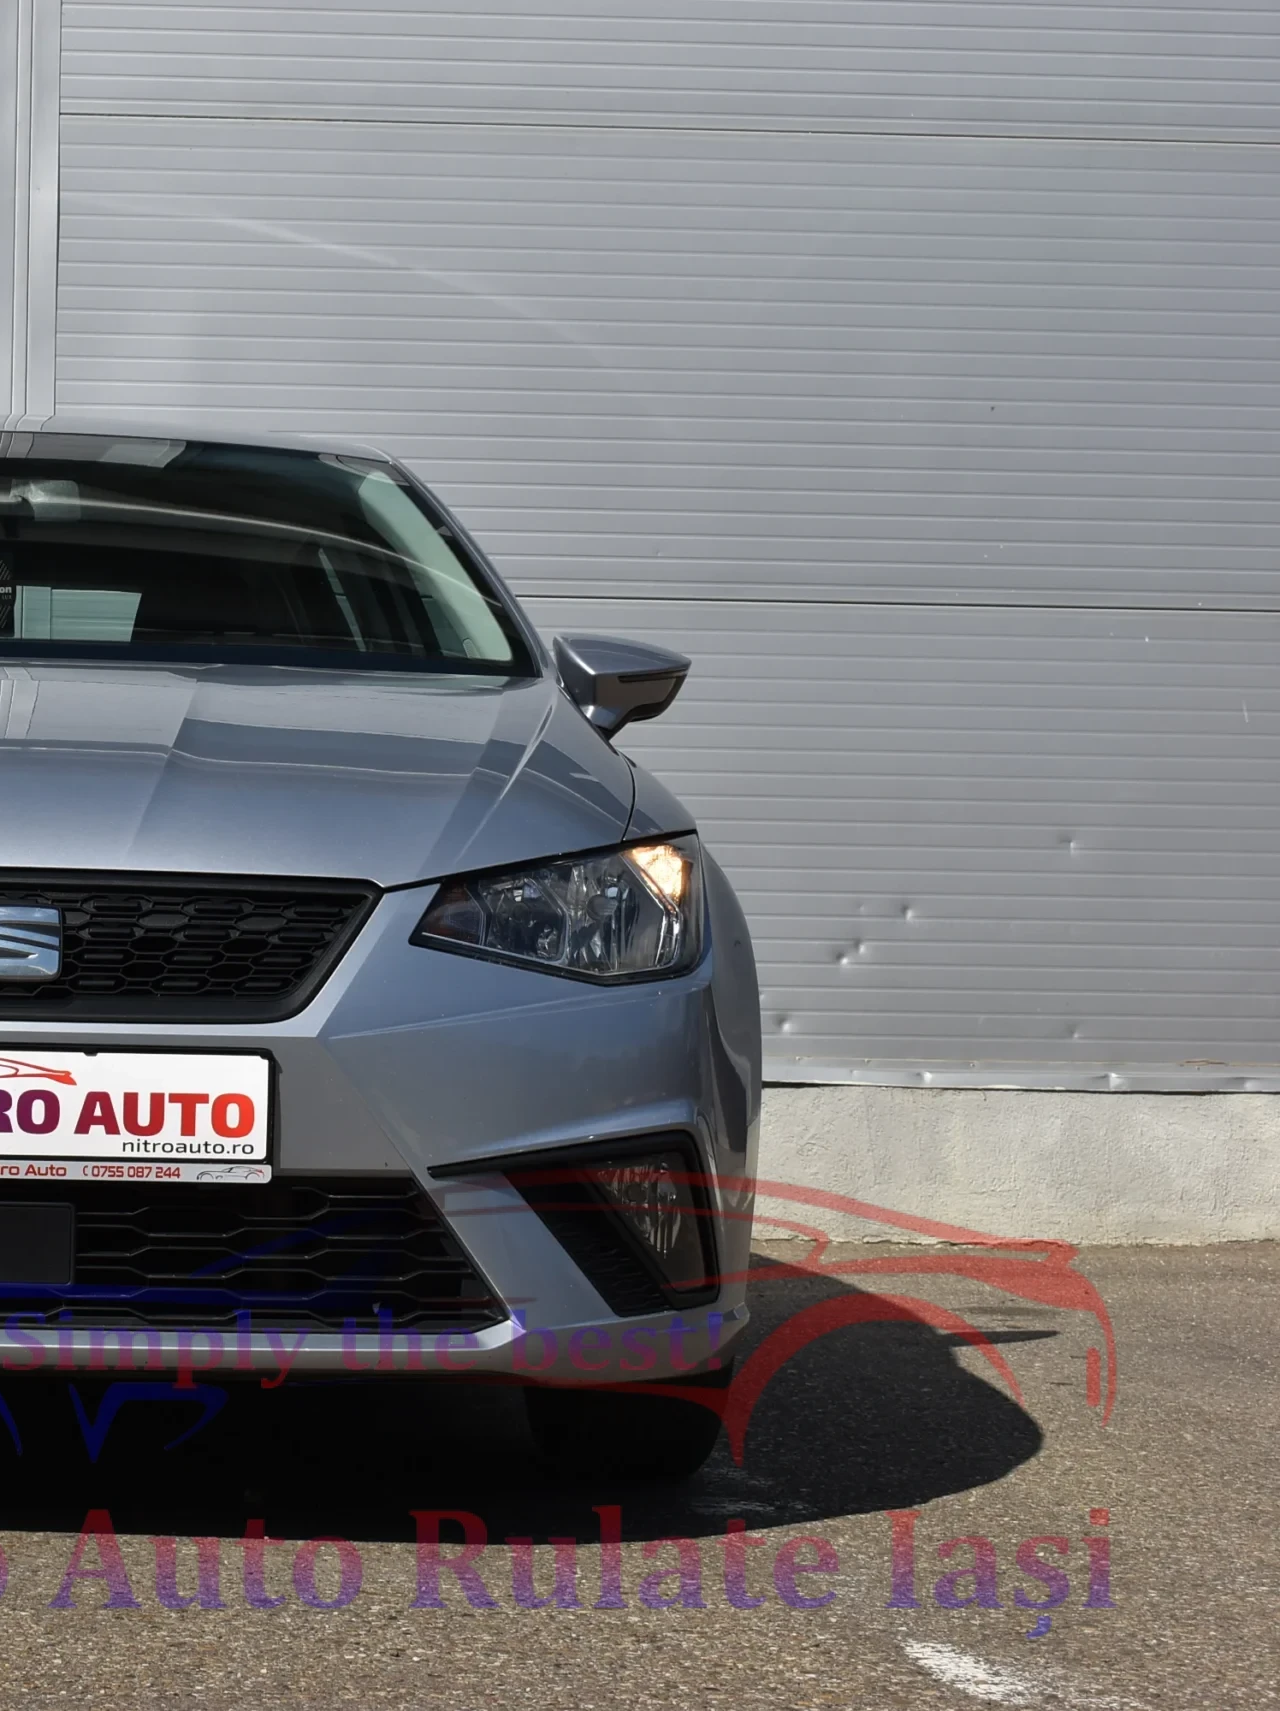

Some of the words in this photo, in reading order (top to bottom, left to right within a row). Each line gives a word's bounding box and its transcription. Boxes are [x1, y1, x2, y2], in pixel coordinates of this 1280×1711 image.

[74, 1092, 255, 1138] AUTO
[122, 1138, 254, 1155] nitroauto.ro
[24, 1164, 67, 1177] Auto
[91, 1165, 124, 1178] 0755
[127, 1166, 152, 1178] 087
[155, 1167, 181, 1179] 244
